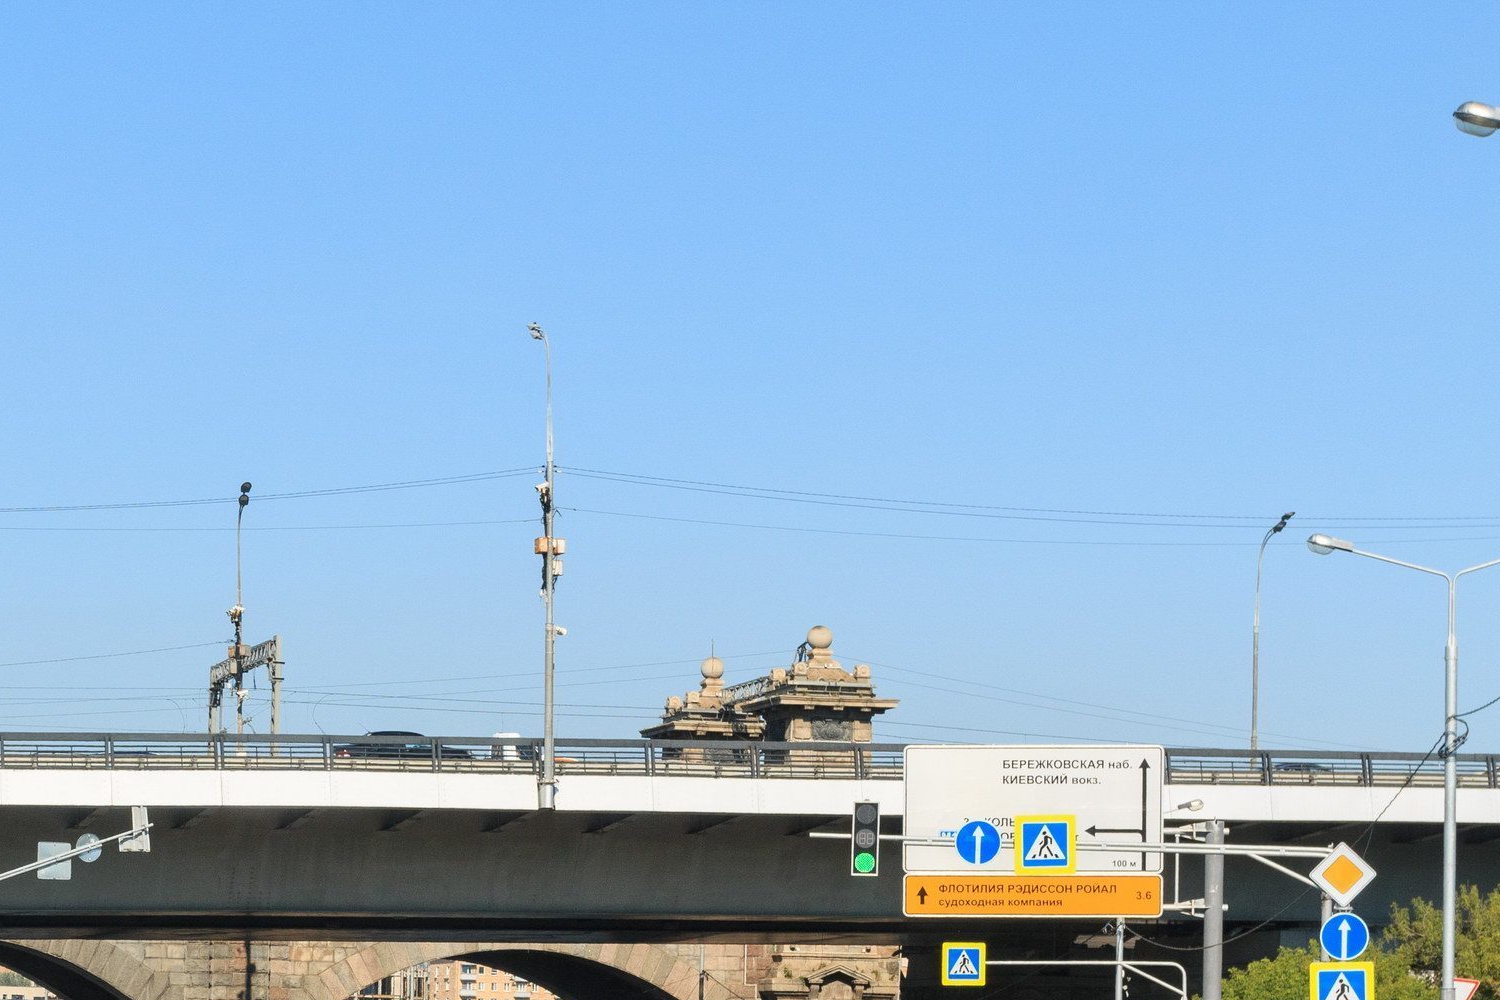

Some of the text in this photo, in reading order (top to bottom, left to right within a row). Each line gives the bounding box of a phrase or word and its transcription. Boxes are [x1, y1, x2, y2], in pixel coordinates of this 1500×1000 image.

[1002, 759, 1133, 769] БЕРЕЖКОВСКАЯ наб.
[1002, 773, 1101, 785] КИЕВСКИЙ вокз.
[1112, 859, 1128, 868] 100
[938, 883, 1117, 895] ФЛОТИЛИЯ РЭДИССОН РОЙАЛ
[1136, 890, 1152, 901] 3.6
[938, 898, 1063, 908] судоходная компания
